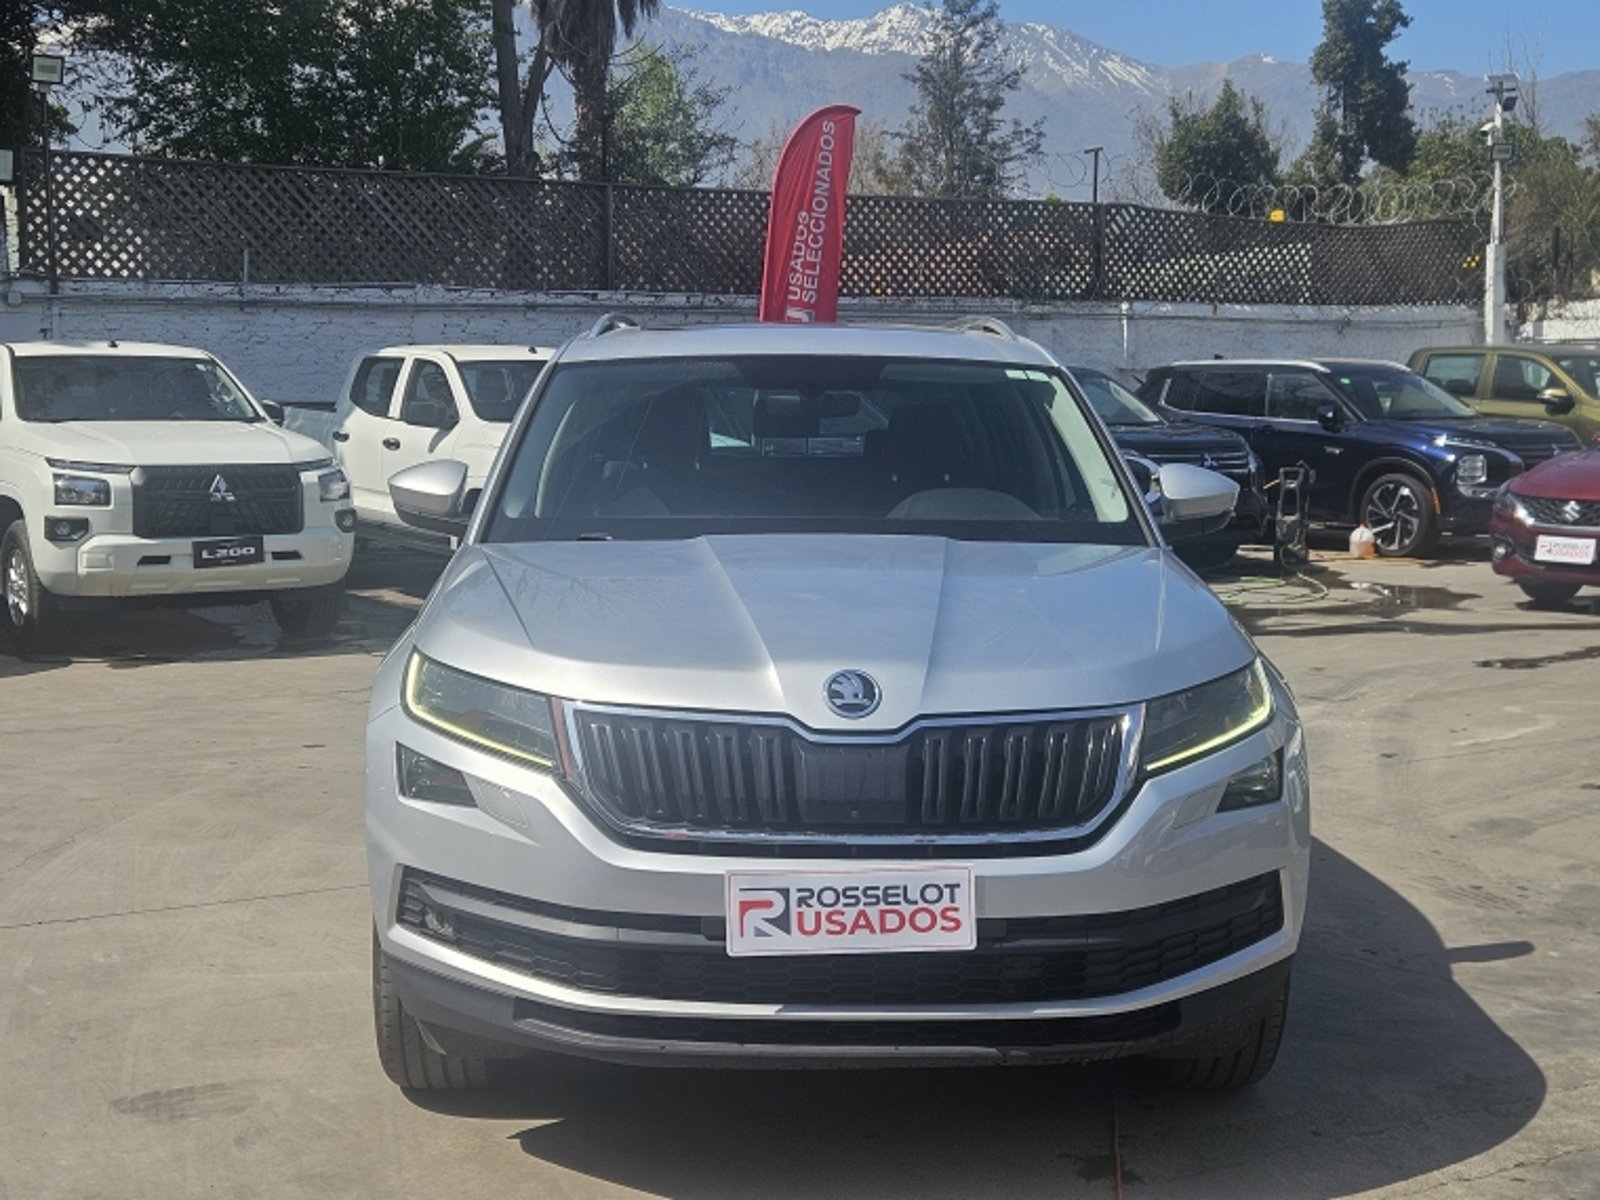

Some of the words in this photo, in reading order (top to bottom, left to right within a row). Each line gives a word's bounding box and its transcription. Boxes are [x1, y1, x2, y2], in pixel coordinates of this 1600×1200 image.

[802, 120, 834, 303] SELECCIONADOS
[787, 212, 809, 300] USADOS
[201, 546, 256, 558] L200
[796, 883, 961, 908] ROSSELOT
[796, 906, 962, 936] USADOS
